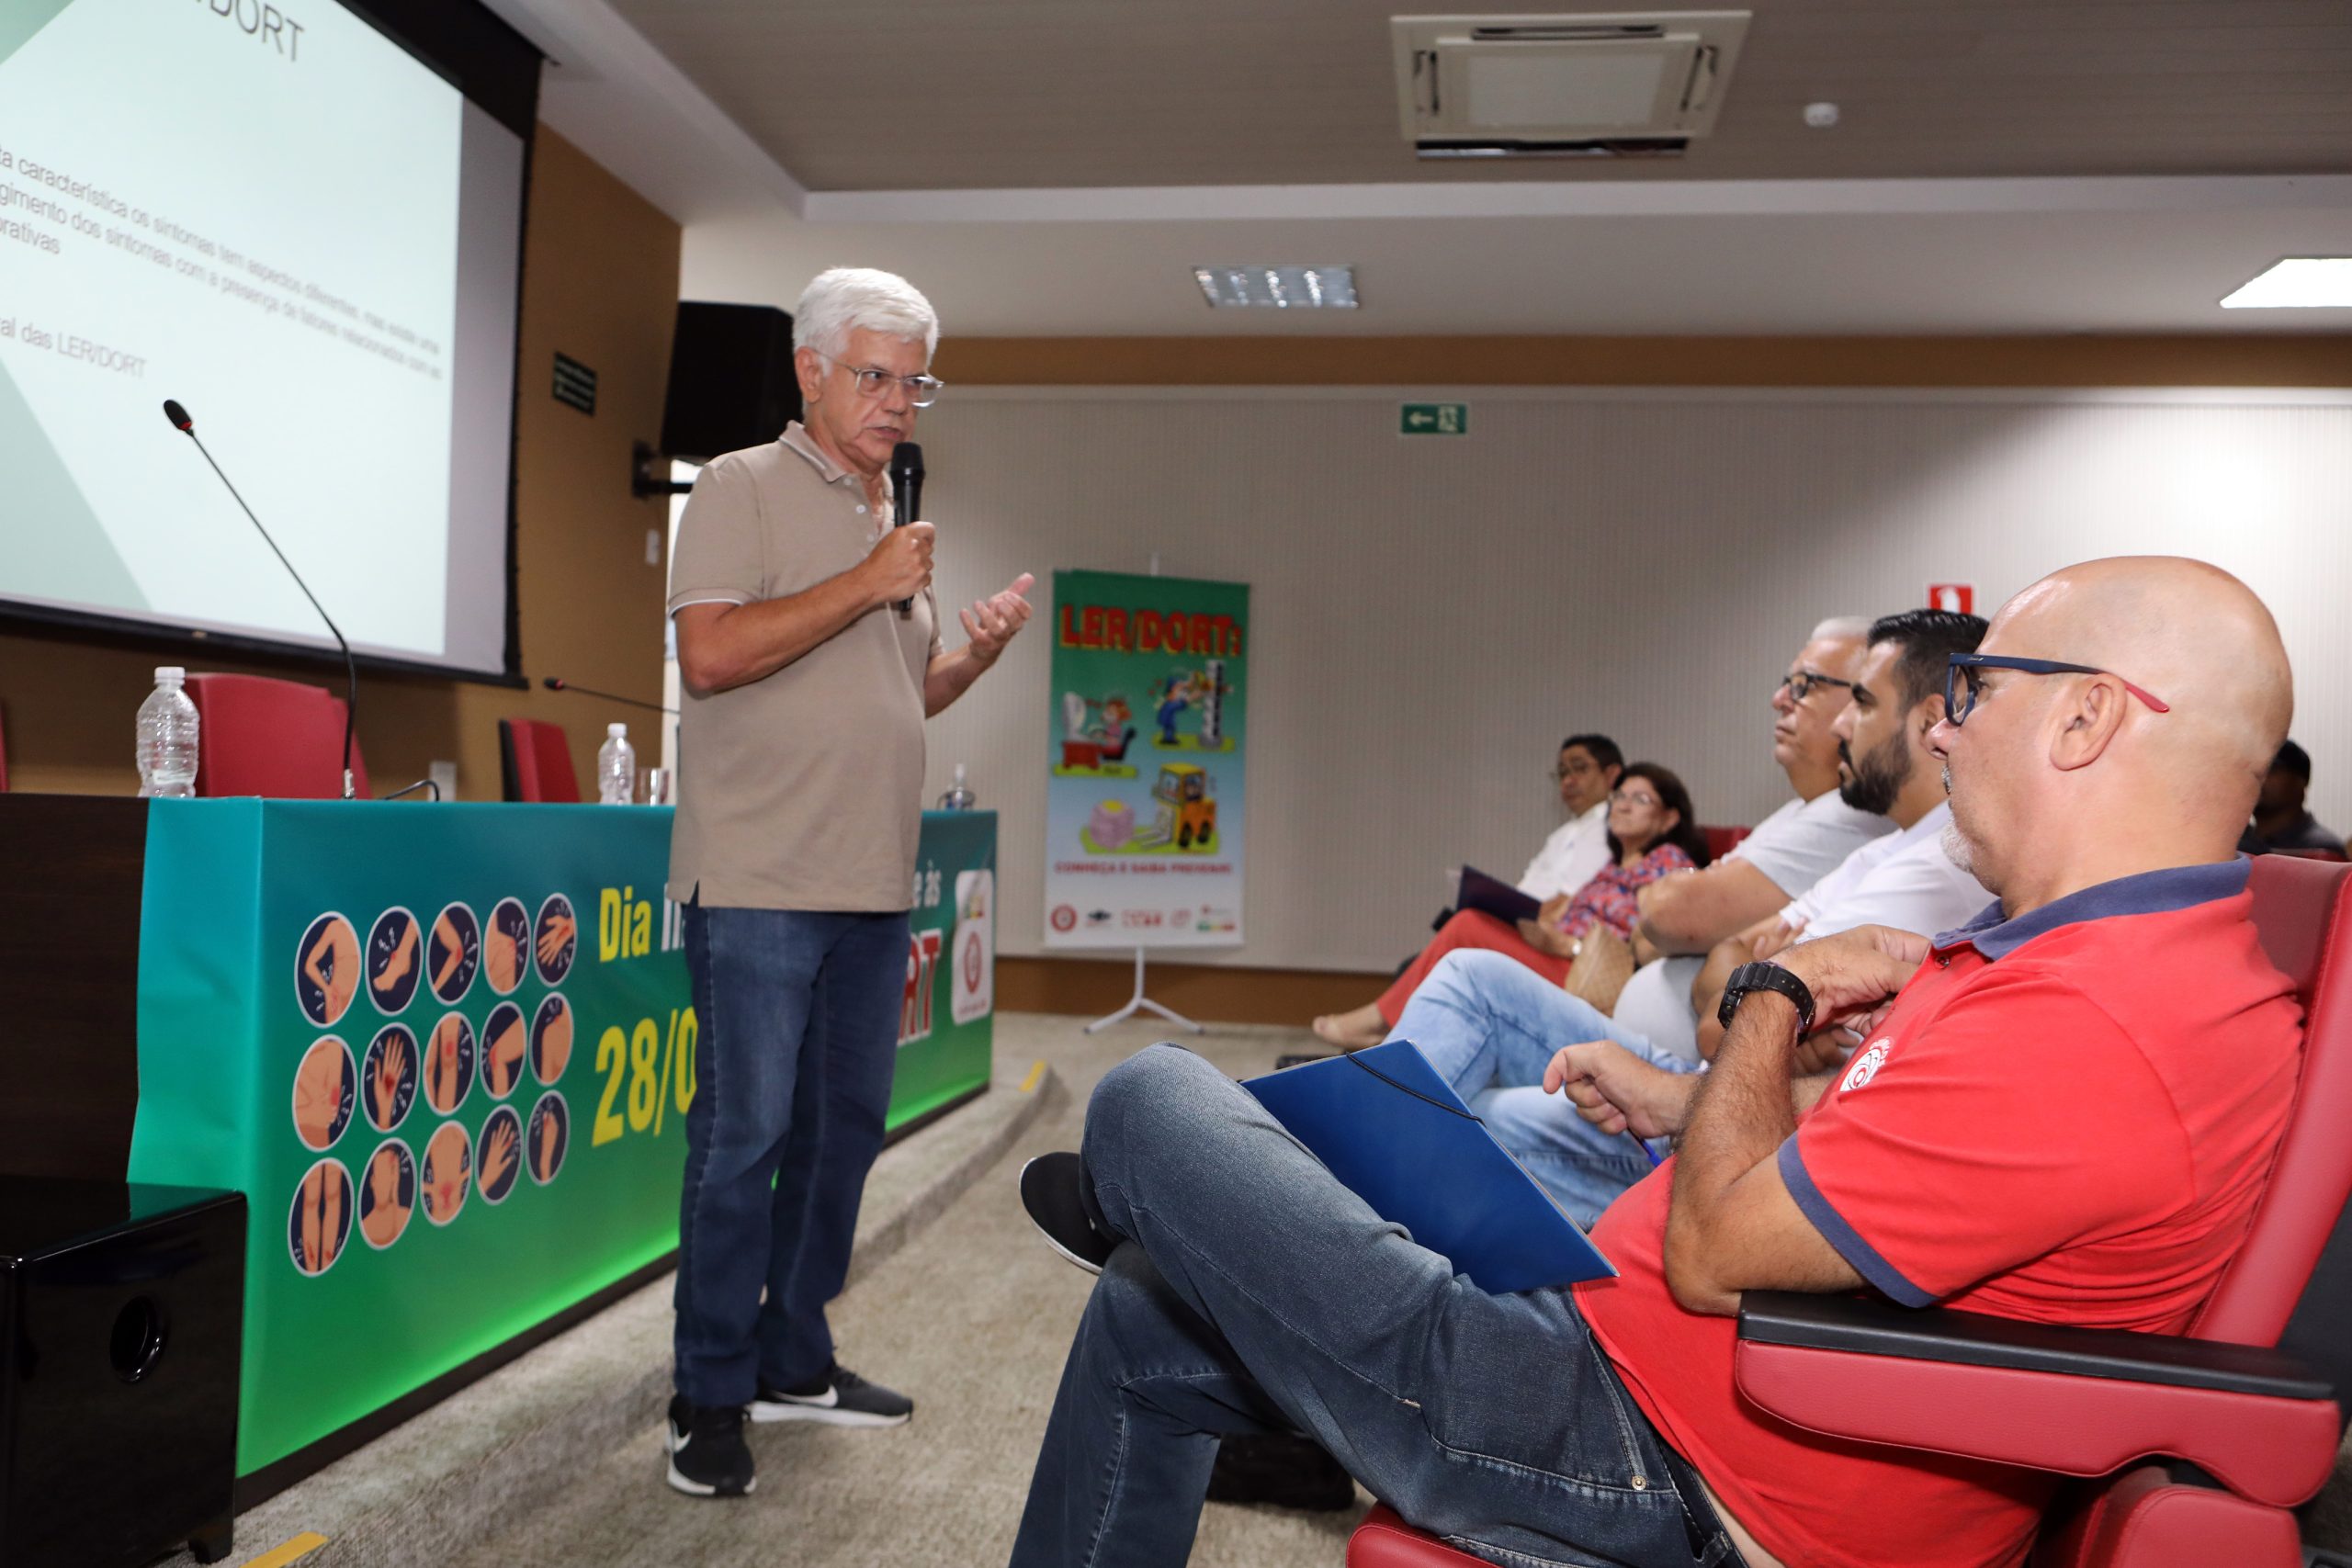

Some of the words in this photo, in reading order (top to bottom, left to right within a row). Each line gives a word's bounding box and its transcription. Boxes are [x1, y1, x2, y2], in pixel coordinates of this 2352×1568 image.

[18, 158, 128, 219] característica
[72, 211, 102, 239] dos
[21, 322, 52, 350] das
[57, 332, 147, 379] LER/DORT
[599, 885, 651, 962] Dia
